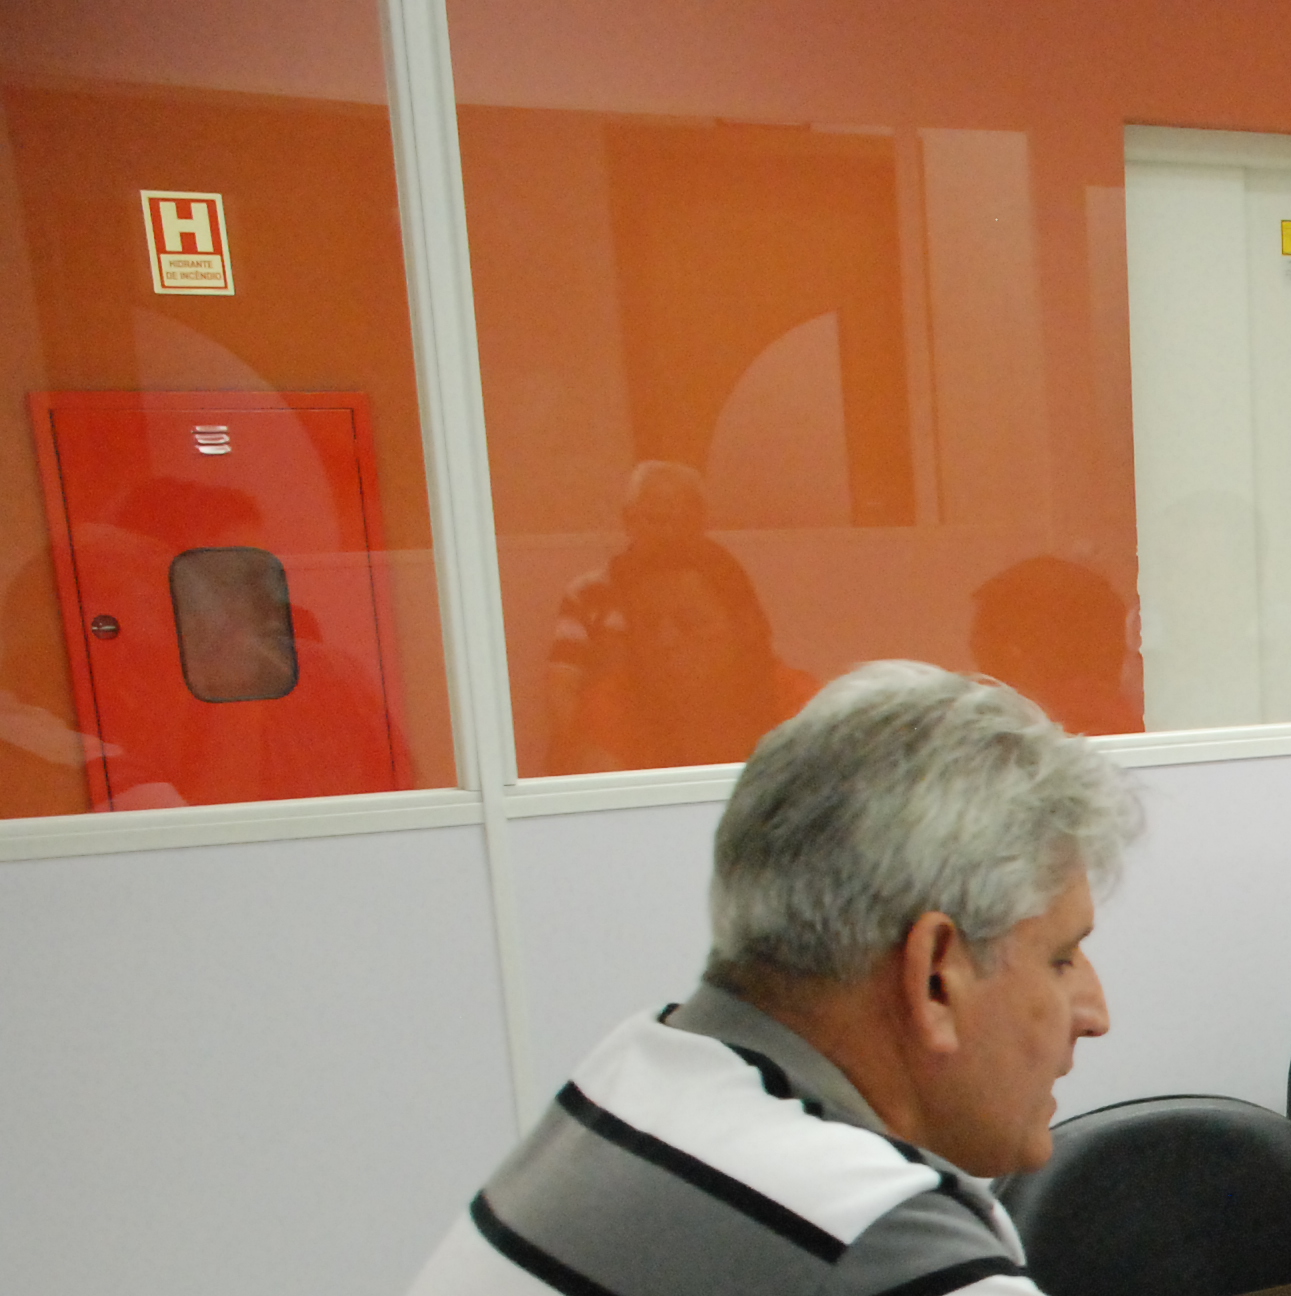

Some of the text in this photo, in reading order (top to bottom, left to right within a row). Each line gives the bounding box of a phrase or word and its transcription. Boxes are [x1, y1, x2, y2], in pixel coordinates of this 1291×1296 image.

[159, 201, 214, 252] H
[169, 260, 213, 269] HIDRANTE
[166, 270, 222, 280] DE INCÊNDIO
